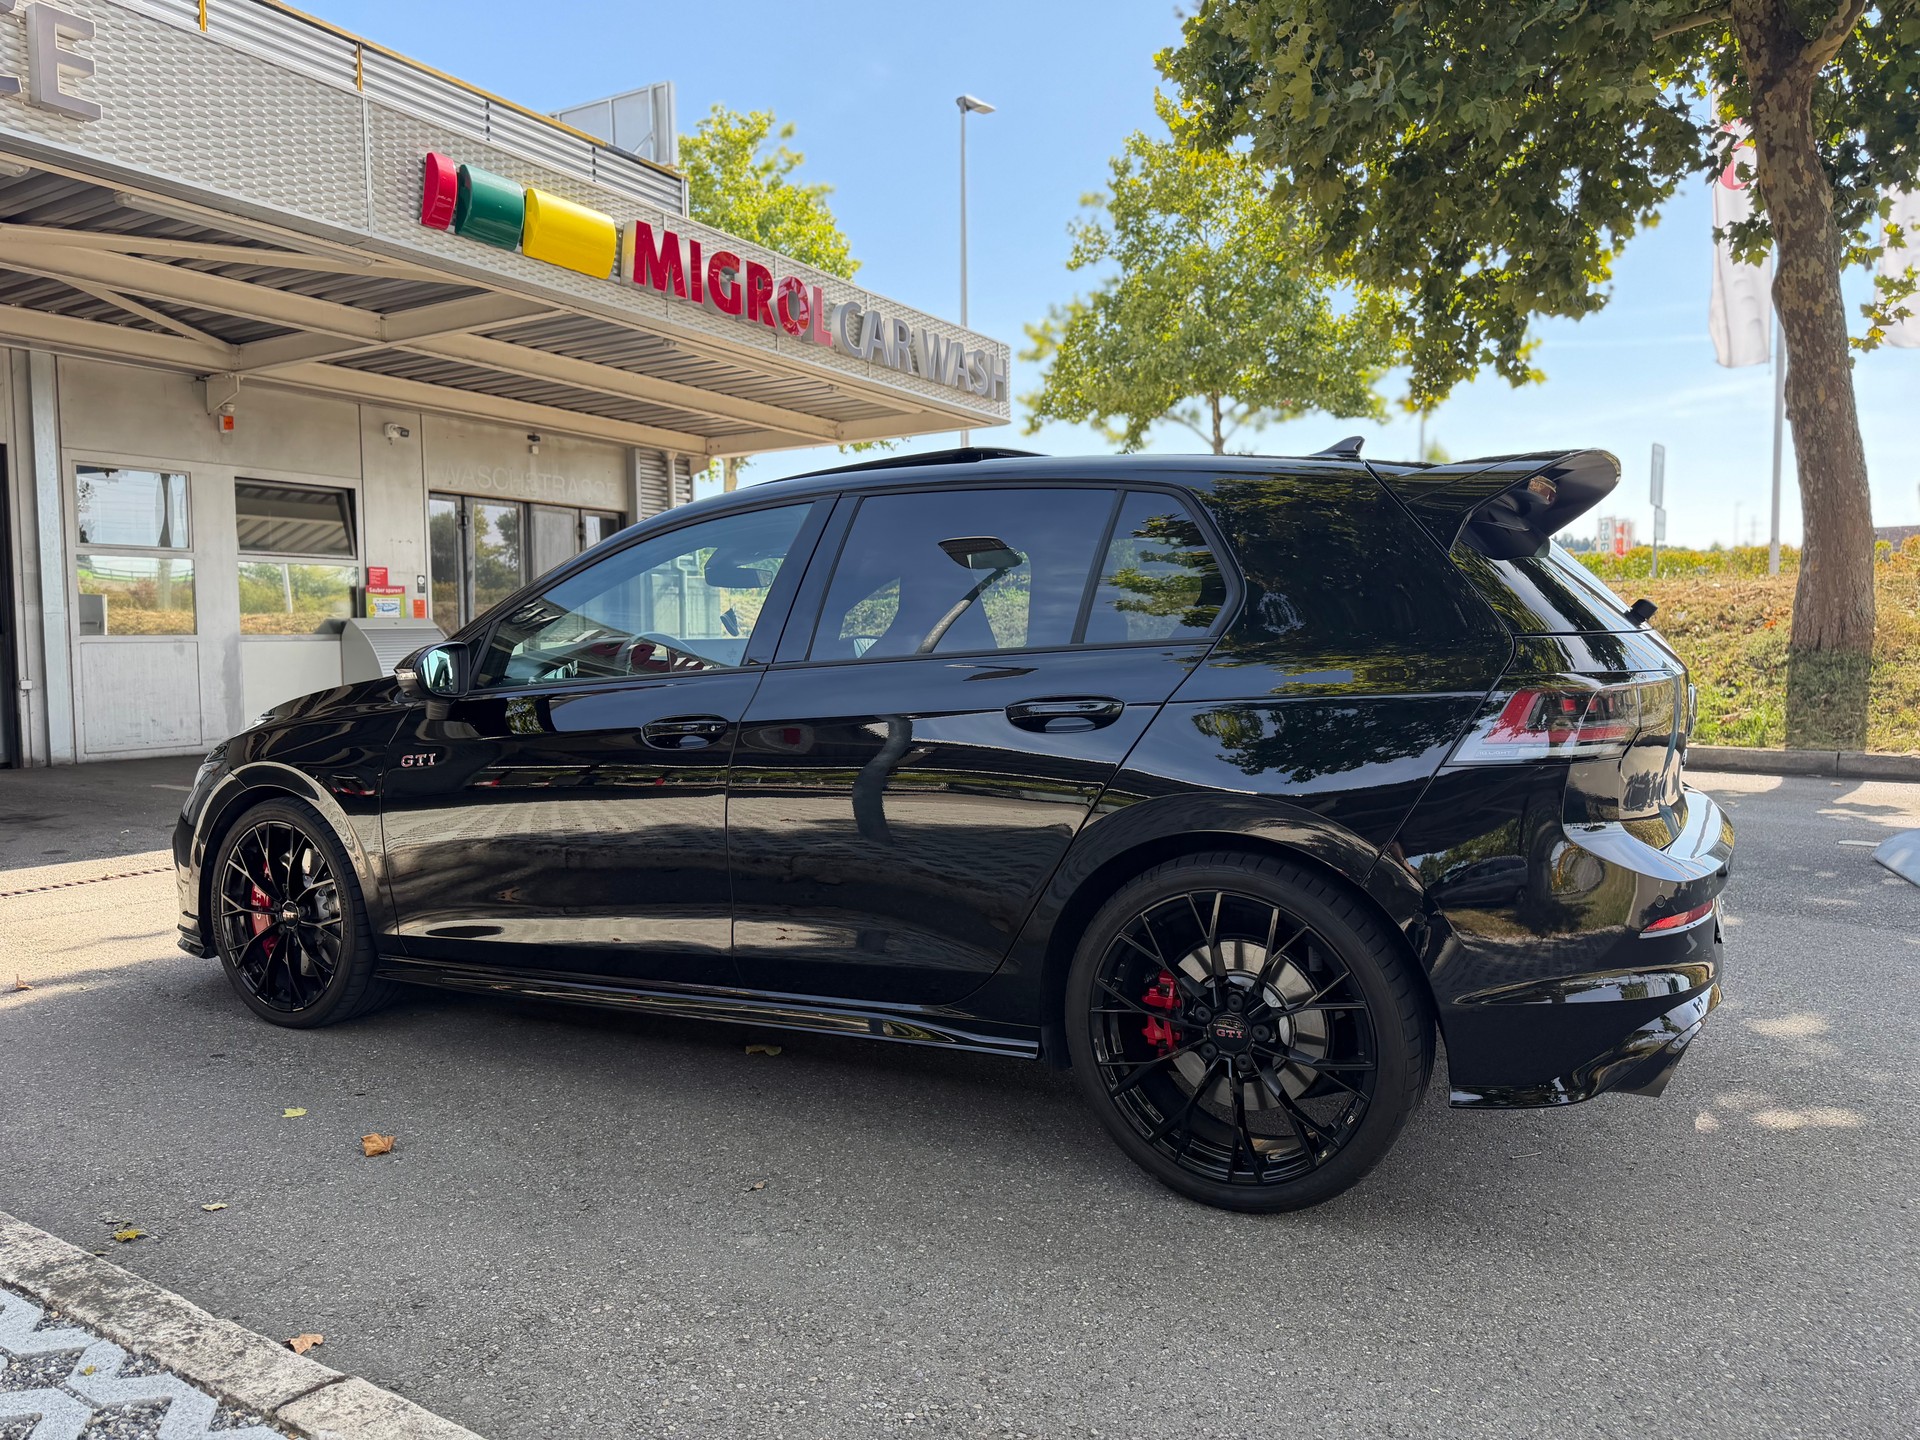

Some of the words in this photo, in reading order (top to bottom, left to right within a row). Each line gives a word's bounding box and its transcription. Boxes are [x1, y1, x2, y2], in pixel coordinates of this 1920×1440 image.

[622, 219, 833, 347] MIGROL
[832, 301, 914, 375] CAR
[914, 327, 1008, 401] WASH
[401, 753, 436, 767] GTI
[1216, 1029, 1242, 1038] GTI
